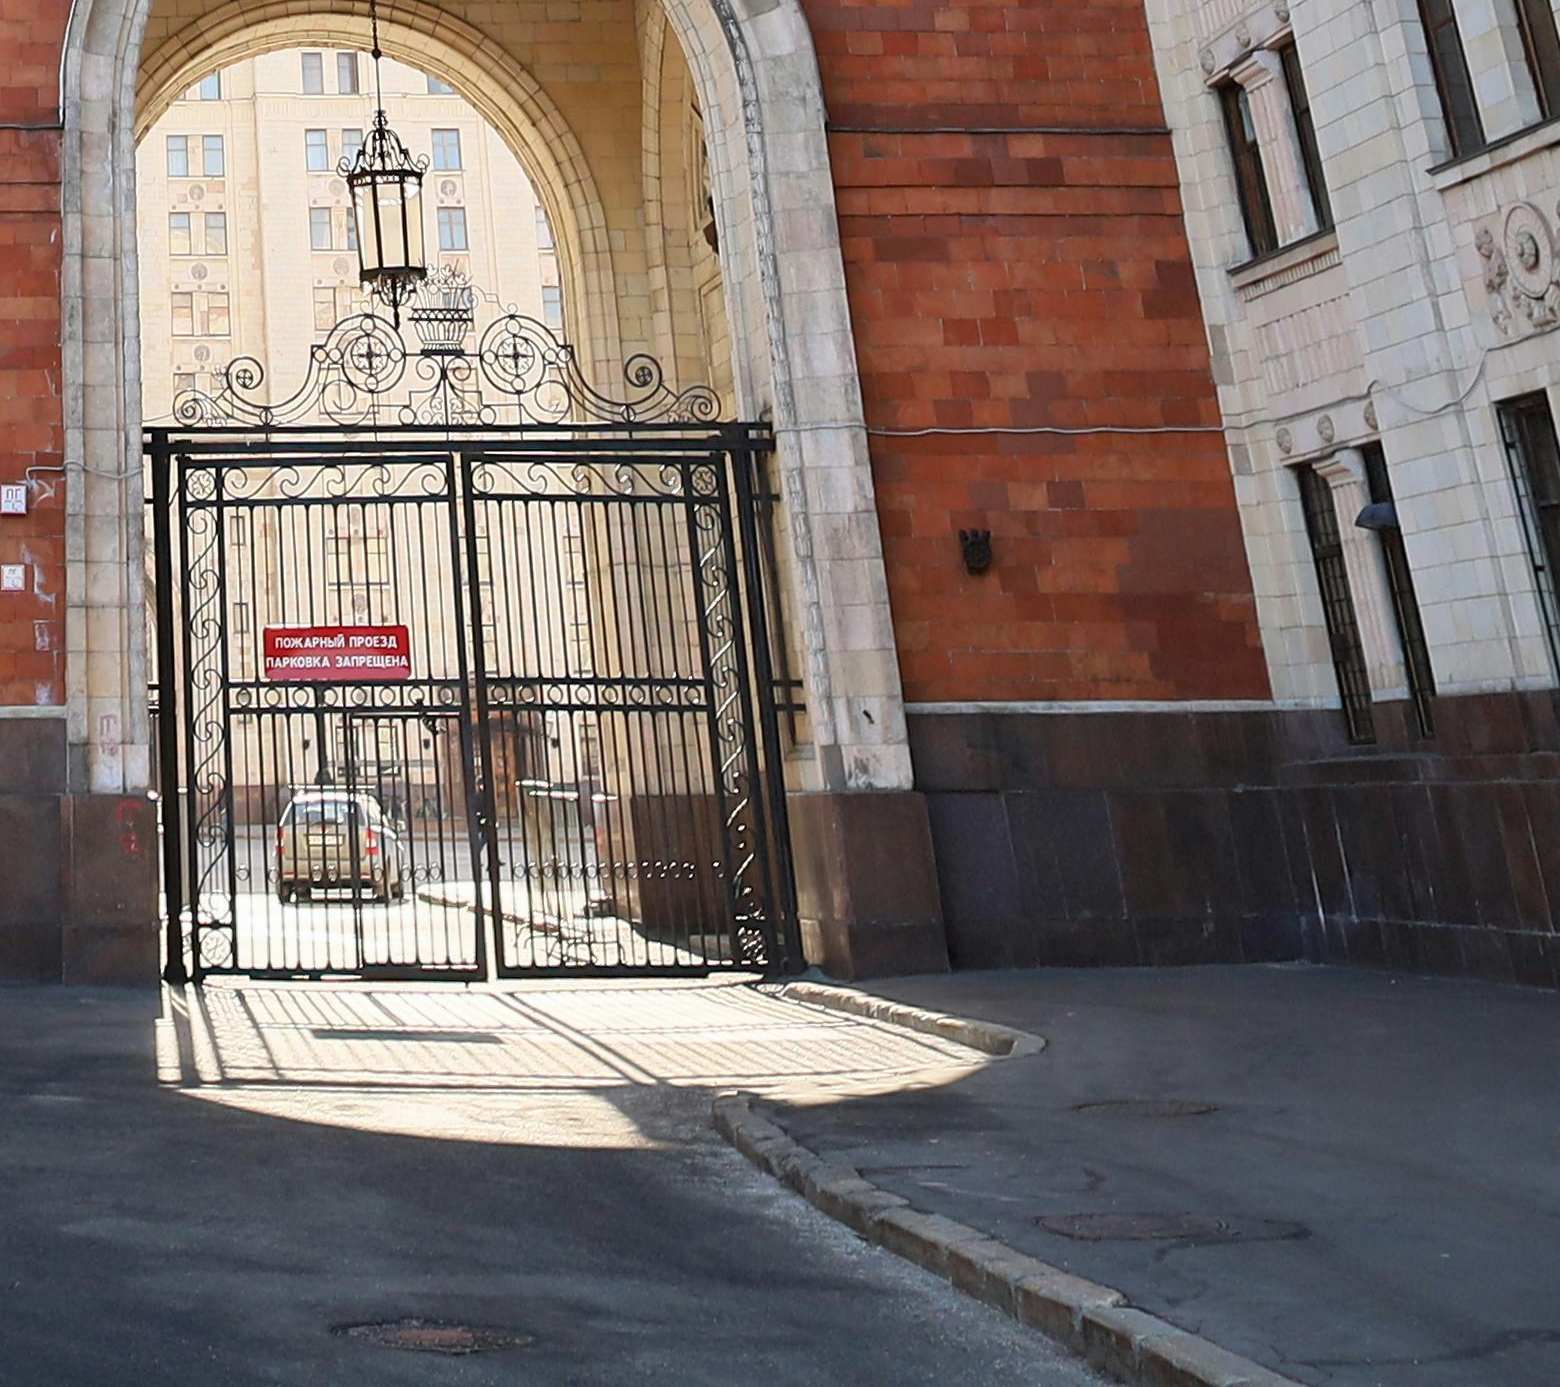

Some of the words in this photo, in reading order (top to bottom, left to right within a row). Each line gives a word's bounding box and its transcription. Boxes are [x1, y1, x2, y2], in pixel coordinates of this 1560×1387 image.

[275, 633, 345, 649] ПОЖАРНЫЙ
[349, 635, 398, 649] ПРОЕЗД
[266, 656, 331, 668] ПАРКОВКА
[335, 655, 409, 669] ЗАПРЕЩЕНА
